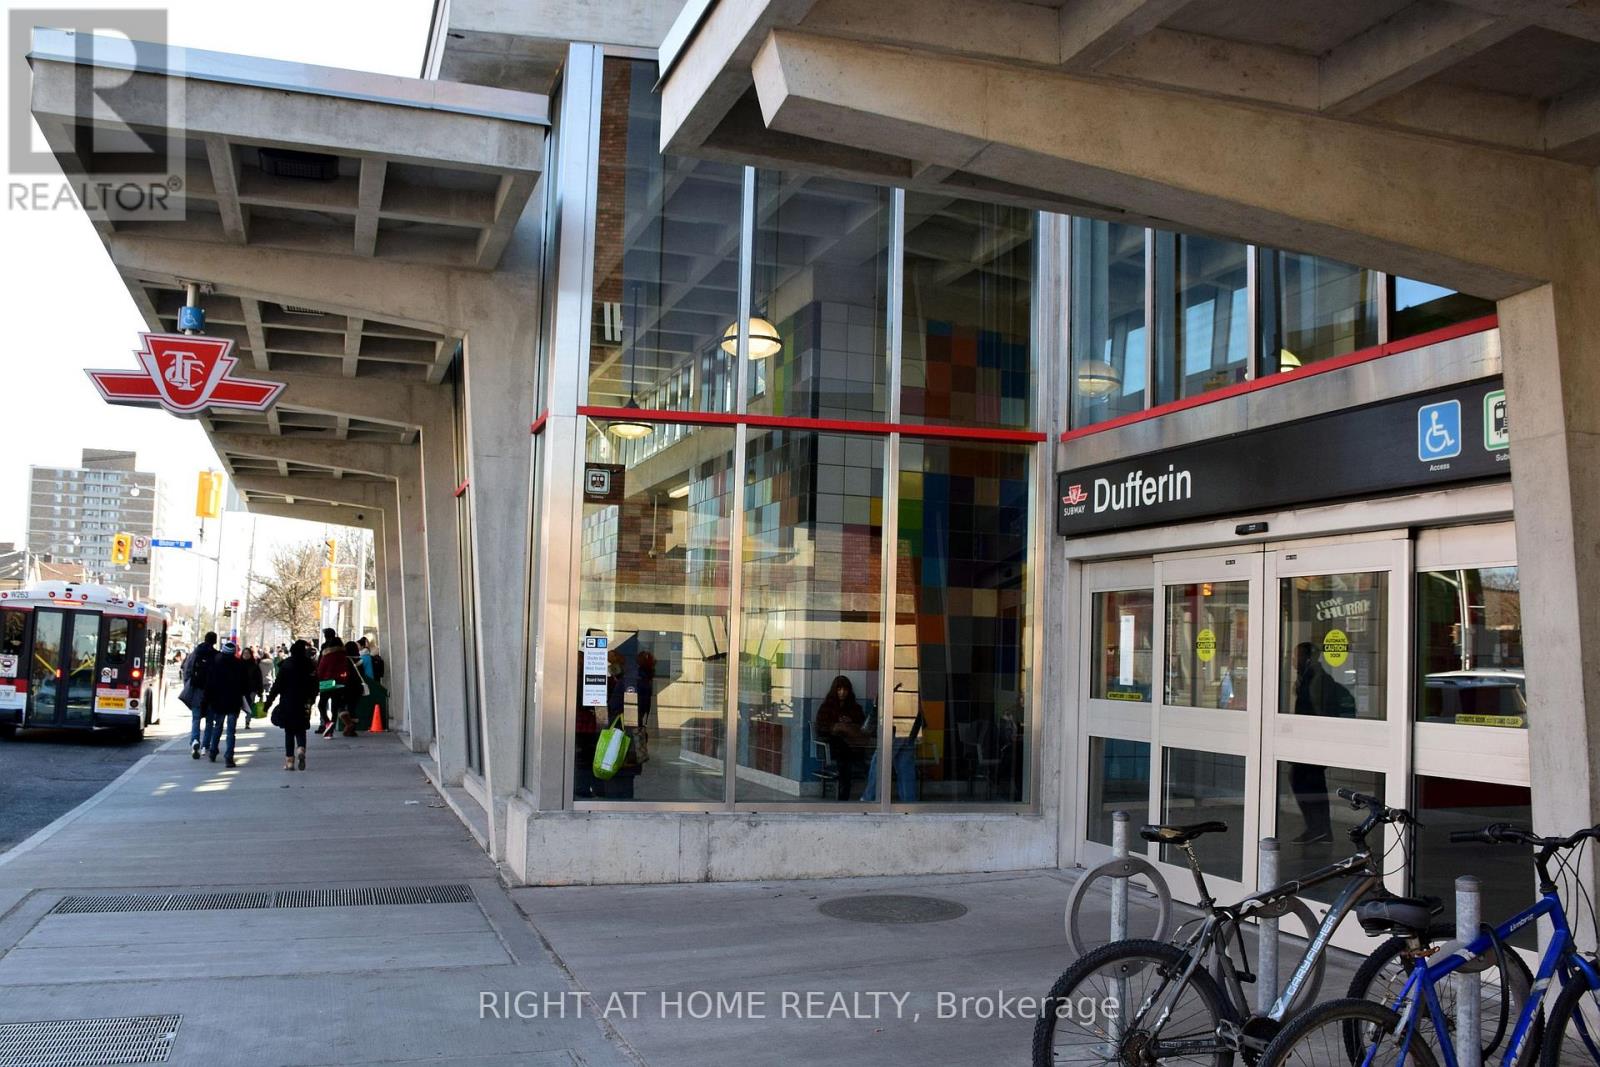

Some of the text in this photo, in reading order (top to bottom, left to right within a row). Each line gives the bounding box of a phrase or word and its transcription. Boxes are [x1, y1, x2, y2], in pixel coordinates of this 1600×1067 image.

[1495, 453, 1510, 462] Sub
[1429, 463, 1450, 472] Access
[1093, 464, 1192, 513] Dufferin
[1063, 504, 1086, 517] SUBWAY
[1324, 644, 1347, 652] CAUTION
[1286, 915, 1337, 996] GARY FISHER
